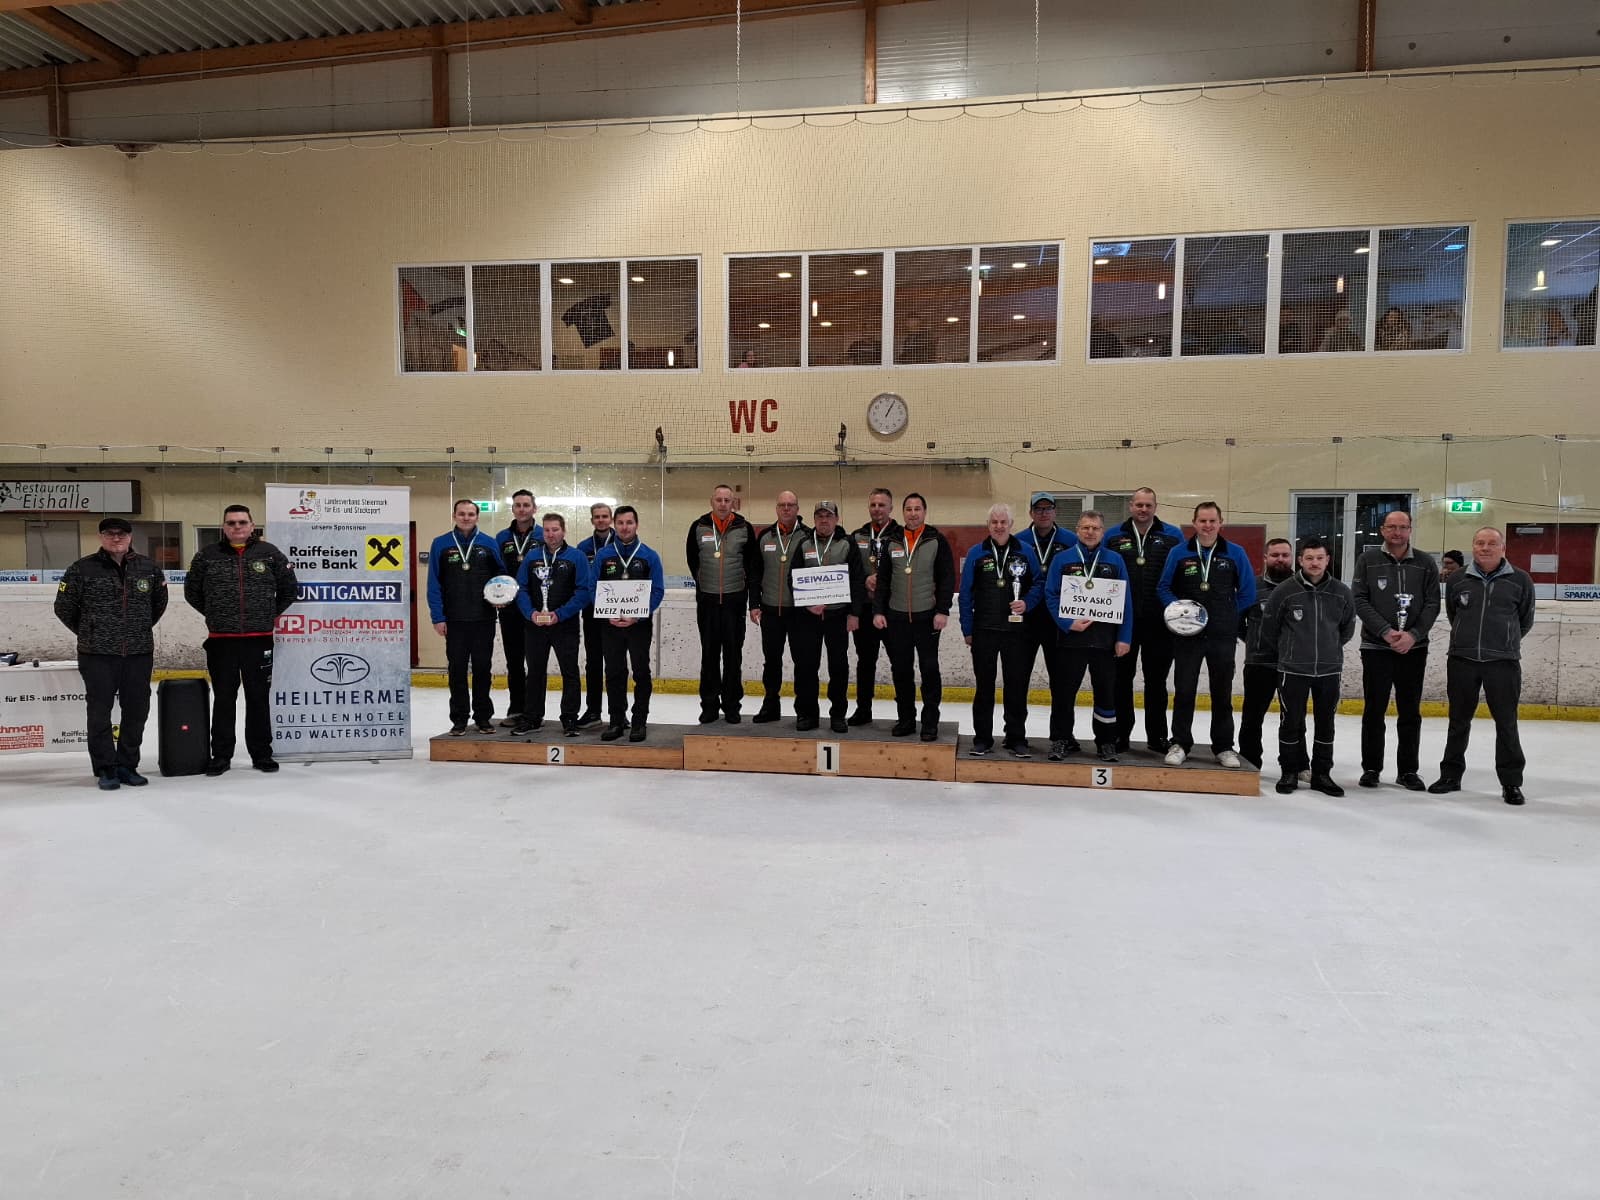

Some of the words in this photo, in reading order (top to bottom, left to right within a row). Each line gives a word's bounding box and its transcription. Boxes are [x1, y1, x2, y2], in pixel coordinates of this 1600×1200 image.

[729, 398, 778, 433] WC
[15, 482, 80, 493] Restaurant
[23, 494, 90, 508] Eishalle
[290, 546, 358, 557] Raiffeisen
[289, 558, 317, 570] eine
[322, 560, 358, 570] Bank
[796, 574, 844, 584] SEIWALD
[296, 586, 396, 600] UNTIGAMER
[1060, 606, 1086, 616] WEIZ
[1089, 608, 1114, 618] Nord
[308, 618, 404, 634] puchmann
[276, 690, 405, 706] HEILTHERME
[276, 712, 405, 724] QUELLENHOTEL
[276, 731, 302, 740] BAD
[309, 728, 405, 739] WALTERSDORF
[551, 748, 560, 762] 2
[824, 746, 832, 770] 1
[1096, 769, 1107, 785] 3
